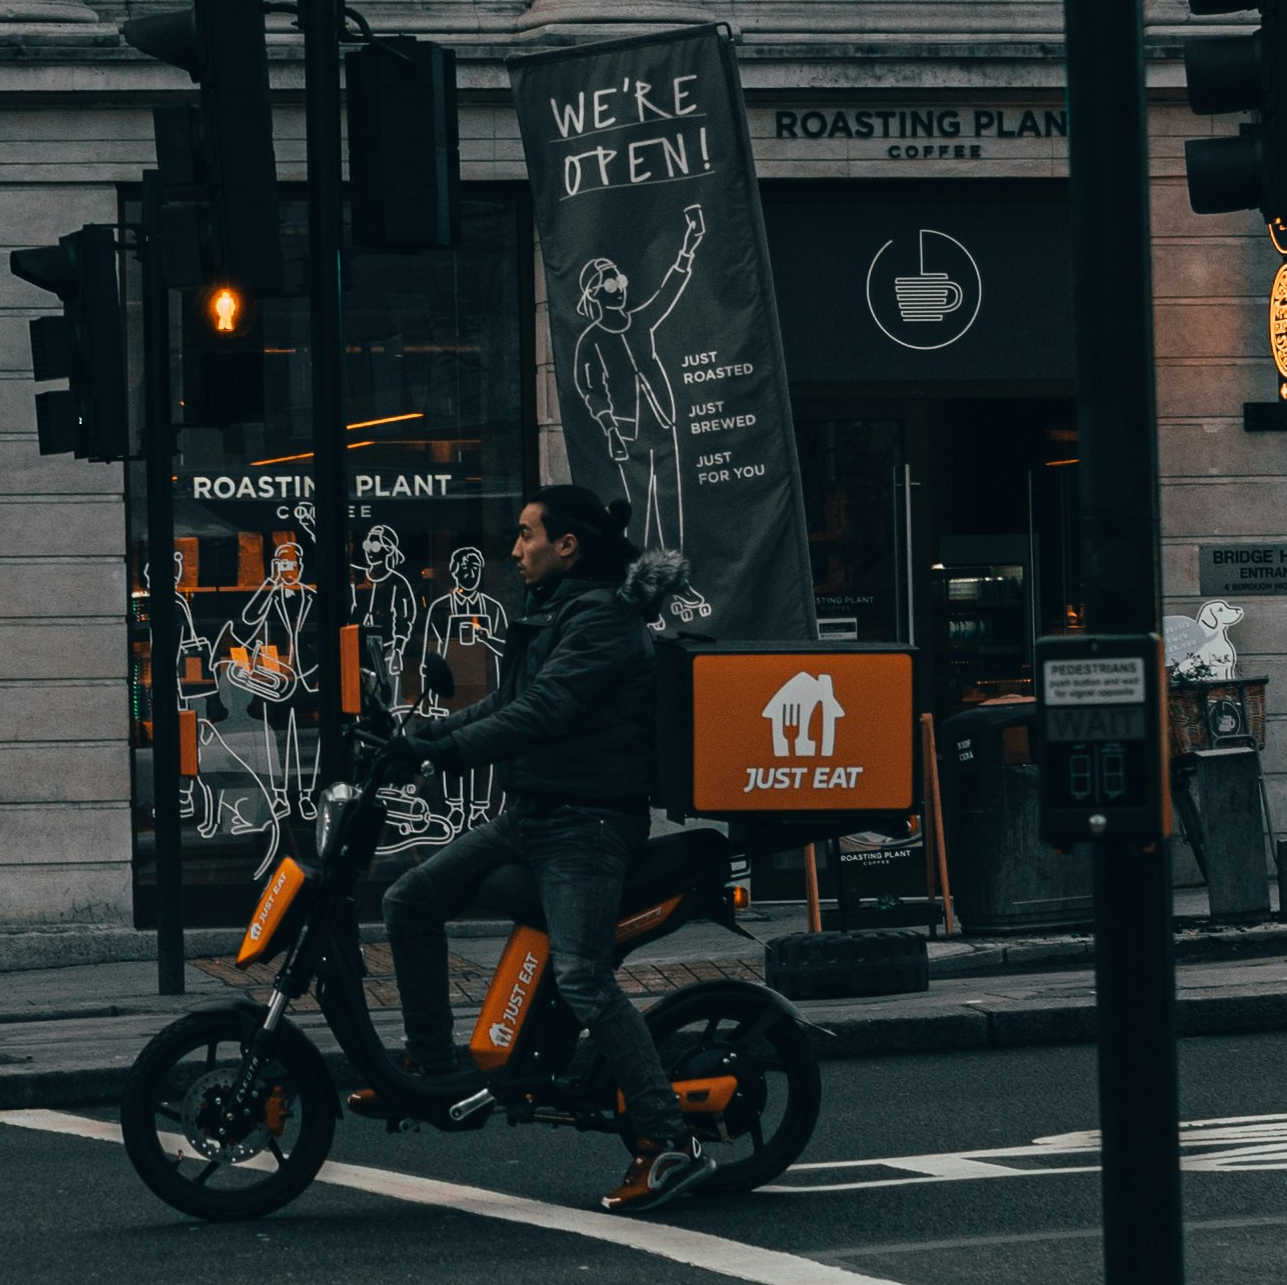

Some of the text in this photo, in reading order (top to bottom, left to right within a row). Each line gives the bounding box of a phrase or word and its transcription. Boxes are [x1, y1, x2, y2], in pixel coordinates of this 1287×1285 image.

[550, 75, 699, 138] WE'RE
[776, 110, 1067, 138] ROASTING PLAN
[564, 127, 711, 196] OPEN!
[888, 145, 981, 158] COFFEE
[681, 351, 717, 367] JUST
[683, 363, 753, 384] ROASTED
[689, 401, 724, 417] JUST
[690, 414, 756, 434] BREWED
[696, 452, 732, 467] JUST
[698, 464, 765, 485] FOR YOU
[193, 474, 452, 499] ROASTIN PLANT
[276, 505, 372, 519] COEE
[1213, 550, 1273, 564] BRIDGE
[1051, 663, 1137, 675] PEDESTRIANS
[1049, 710, 1138, 736] WAIT
[743, 766, 863, 793] JUST EAT
[840, 849, 911, 862] ROASTING PLANT
[259, 870, 287, 923] JUST EAT
[503, 951, 539, 1025] JUST EAT
